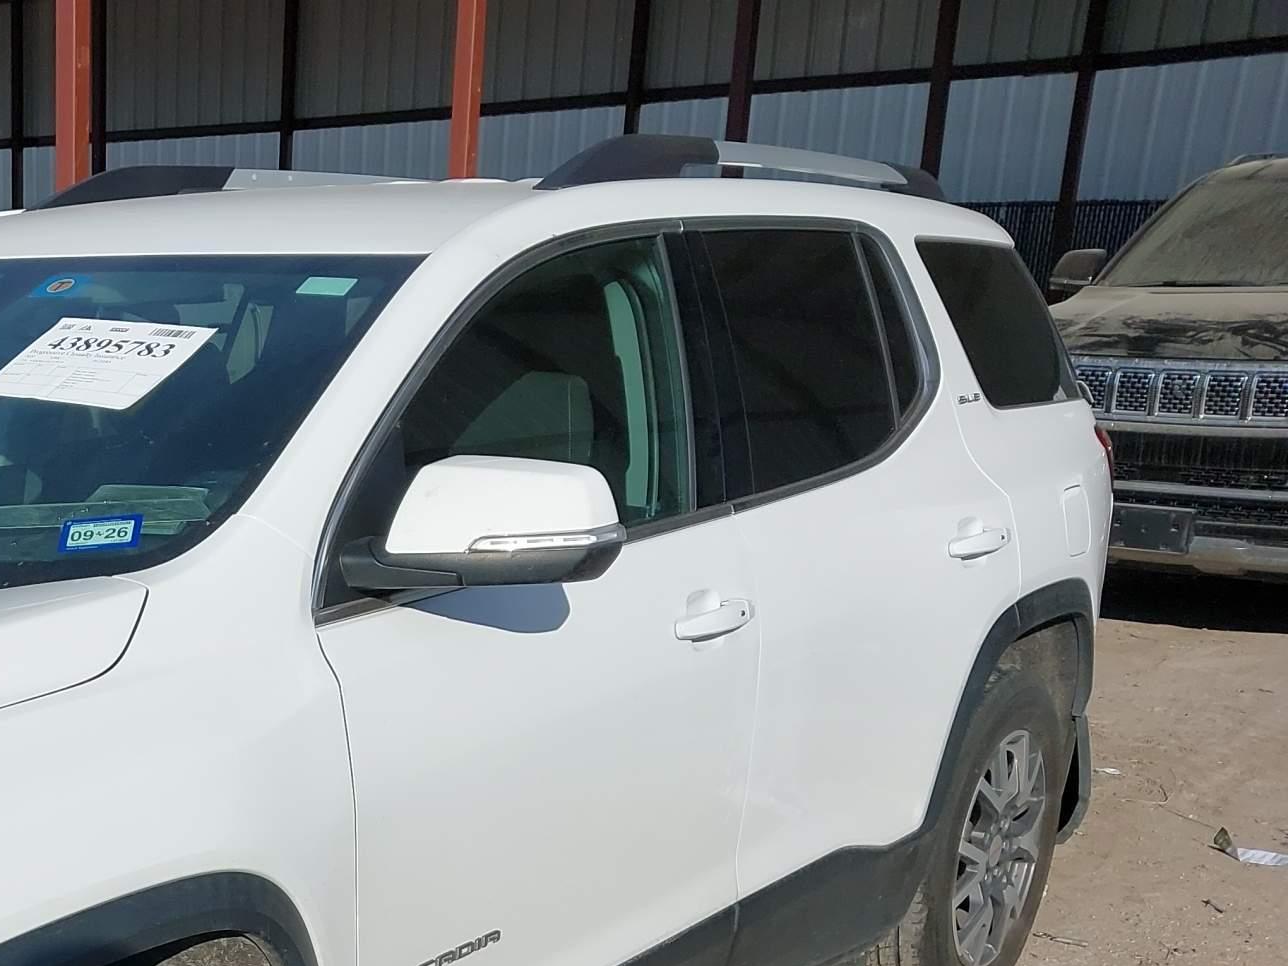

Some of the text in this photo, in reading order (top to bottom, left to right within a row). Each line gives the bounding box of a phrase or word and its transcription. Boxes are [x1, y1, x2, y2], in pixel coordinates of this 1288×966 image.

[48, 335, 176, 358] 43895783
[957, 392, 981, 405] SLE
[70, 526, 128, 542] 09 26
